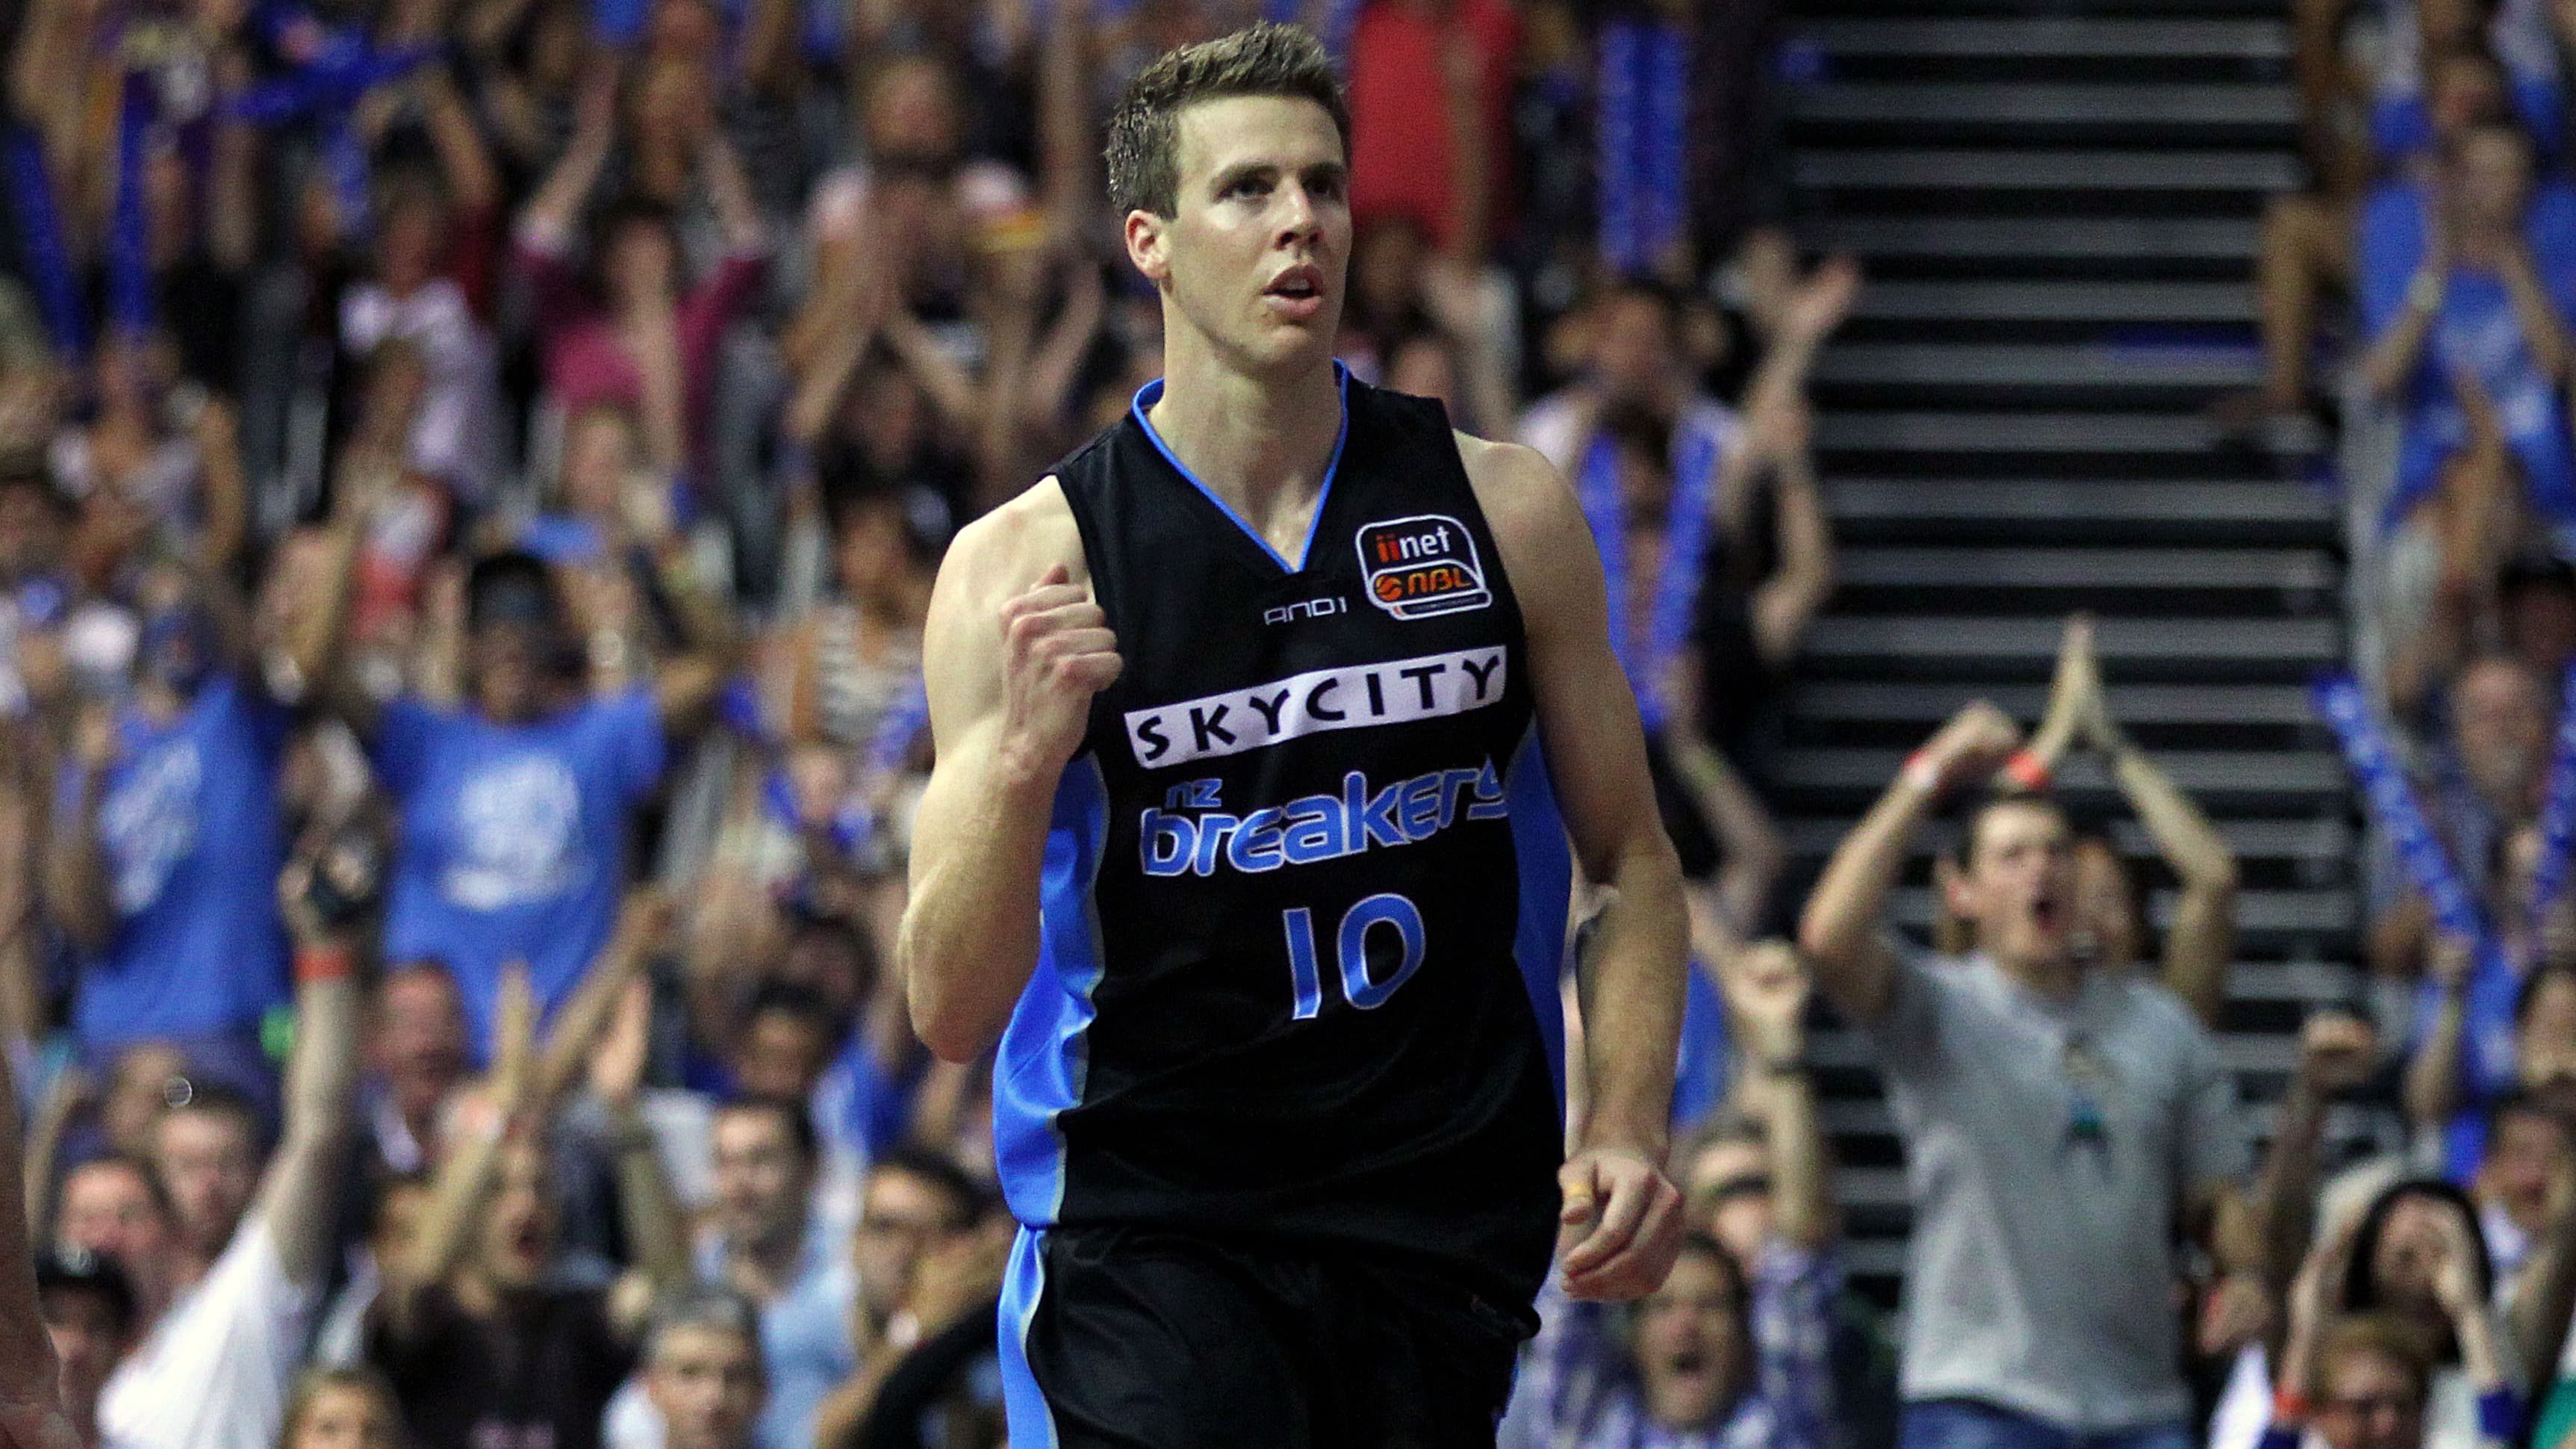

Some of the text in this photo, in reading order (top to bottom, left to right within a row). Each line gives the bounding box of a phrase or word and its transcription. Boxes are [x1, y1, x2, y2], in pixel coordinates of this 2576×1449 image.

[1375, 525, 1451, 562] iinet
[1135, 654, 1500, 761] SKYCITY
[1282, 893, 1425, 1020] 10
